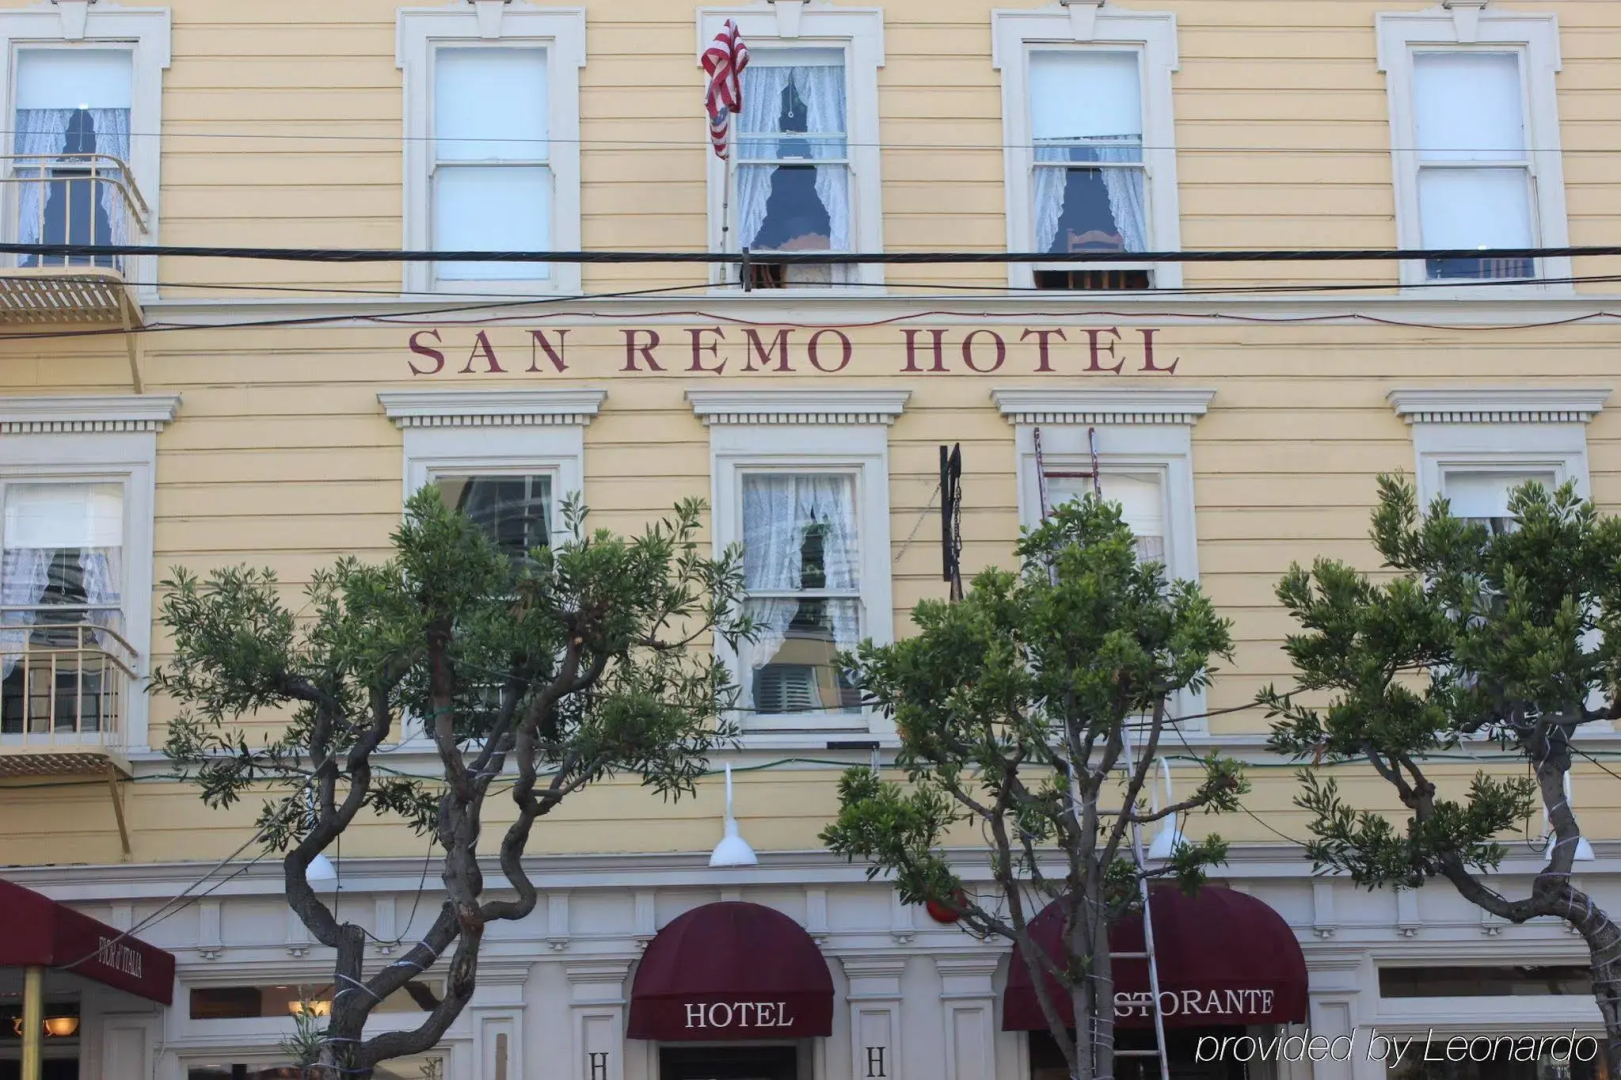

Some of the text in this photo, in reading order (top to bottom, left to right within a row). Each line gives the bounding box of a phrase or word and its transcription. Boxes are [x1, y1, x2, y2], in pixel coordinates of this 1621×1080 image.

[407, 326, 1180, 376] SAN REMO HOTEL
[684, 1001, 794, 1028] HOTEL
[1113, 989, 1274, 1017] STORANTE
[866, 1046, 886, 1077] H
